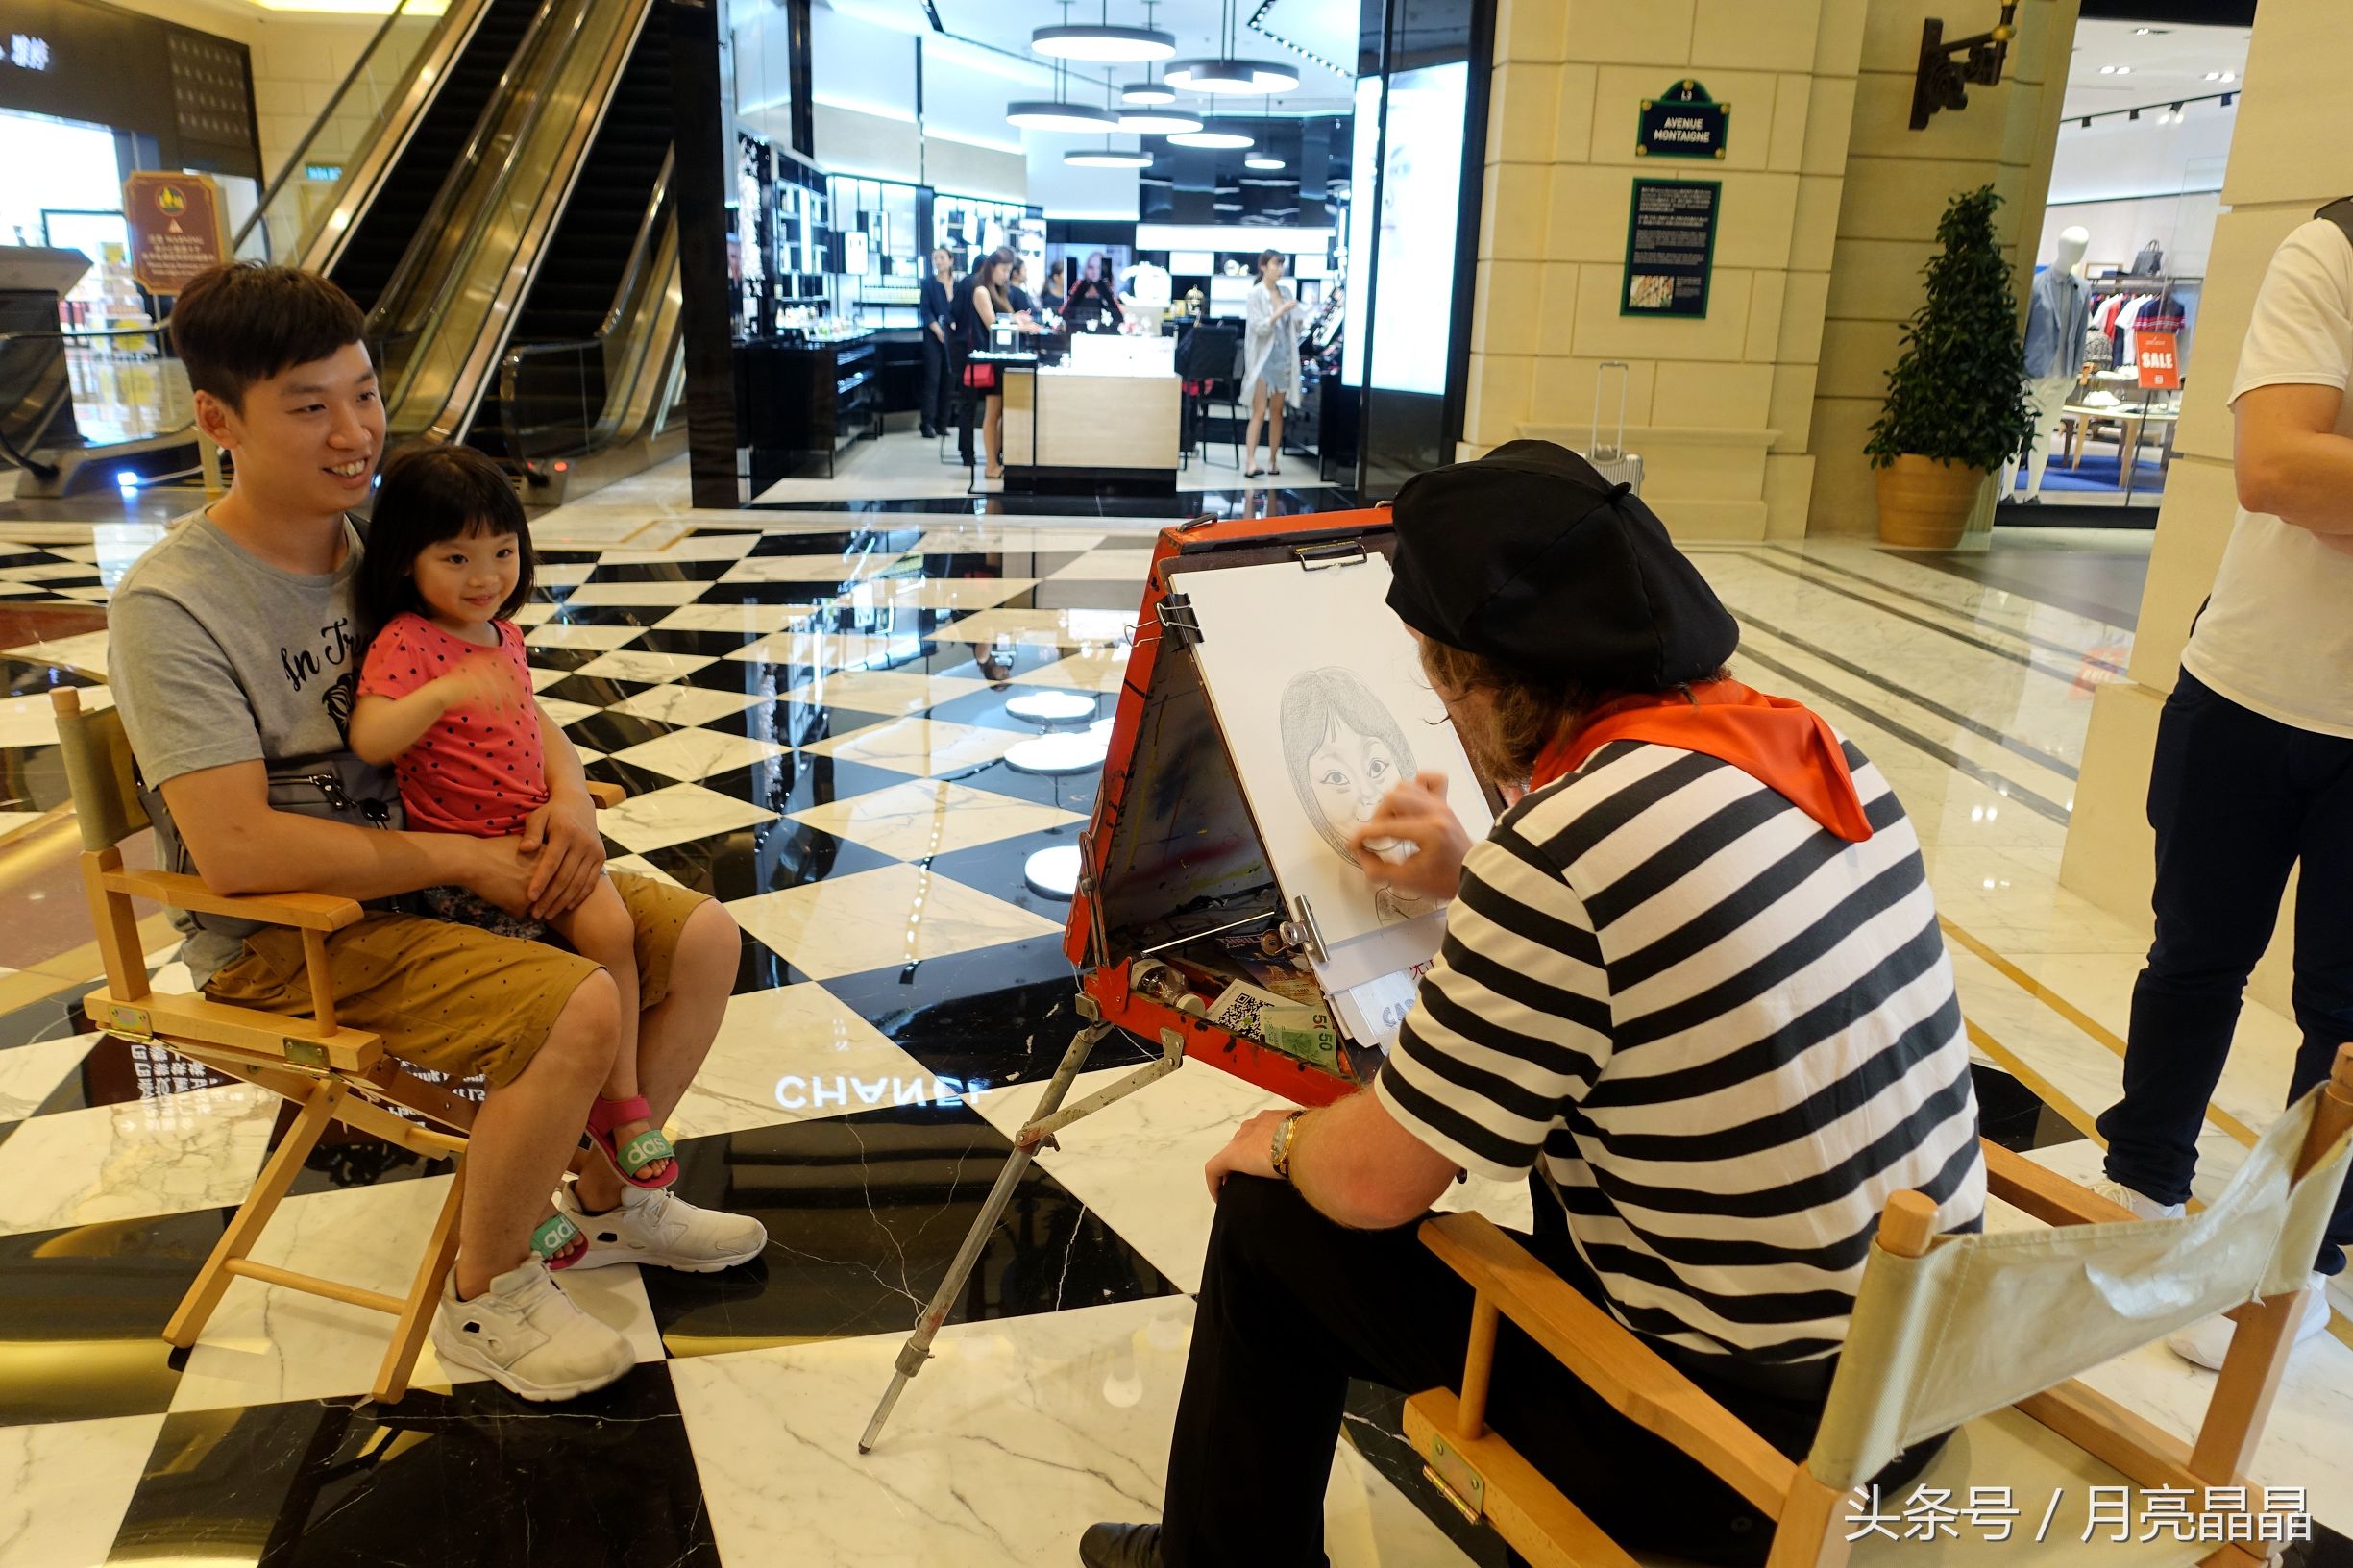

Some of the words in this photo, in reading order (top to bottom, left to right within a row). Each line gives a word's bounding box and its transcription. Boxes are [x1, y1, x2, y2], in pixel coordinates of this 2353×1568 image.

[1664, 116, 1703, 131] AVENUE
[1654, 129, 1710, 143] MONTAIGNE
[2142, 352, 2174, 369] SALE
[281, 647, 320, 692] In
[1319, 1032, 1333, 1051] 50
